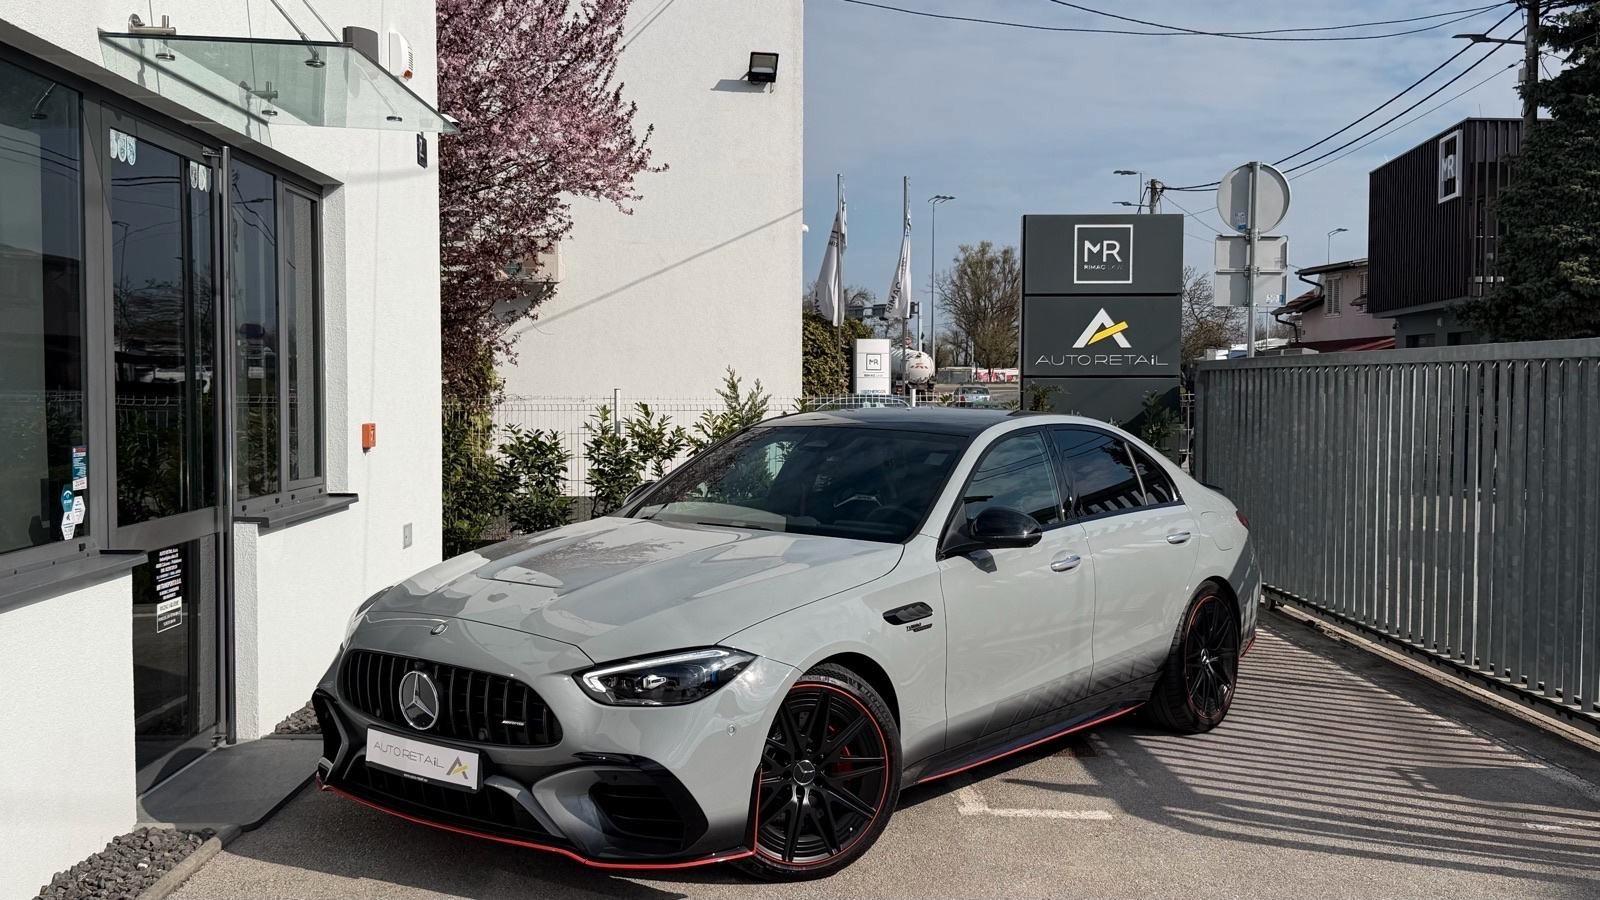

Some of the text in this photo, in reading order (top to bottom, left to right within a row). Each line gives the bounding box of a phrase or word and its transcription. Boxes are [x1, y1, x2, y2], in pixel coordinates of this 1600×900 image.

[1441, 154, 1455, 182] MR
[1084, 240, 1122, 262] MR
[886, 281, 901, 314] RIMAC
